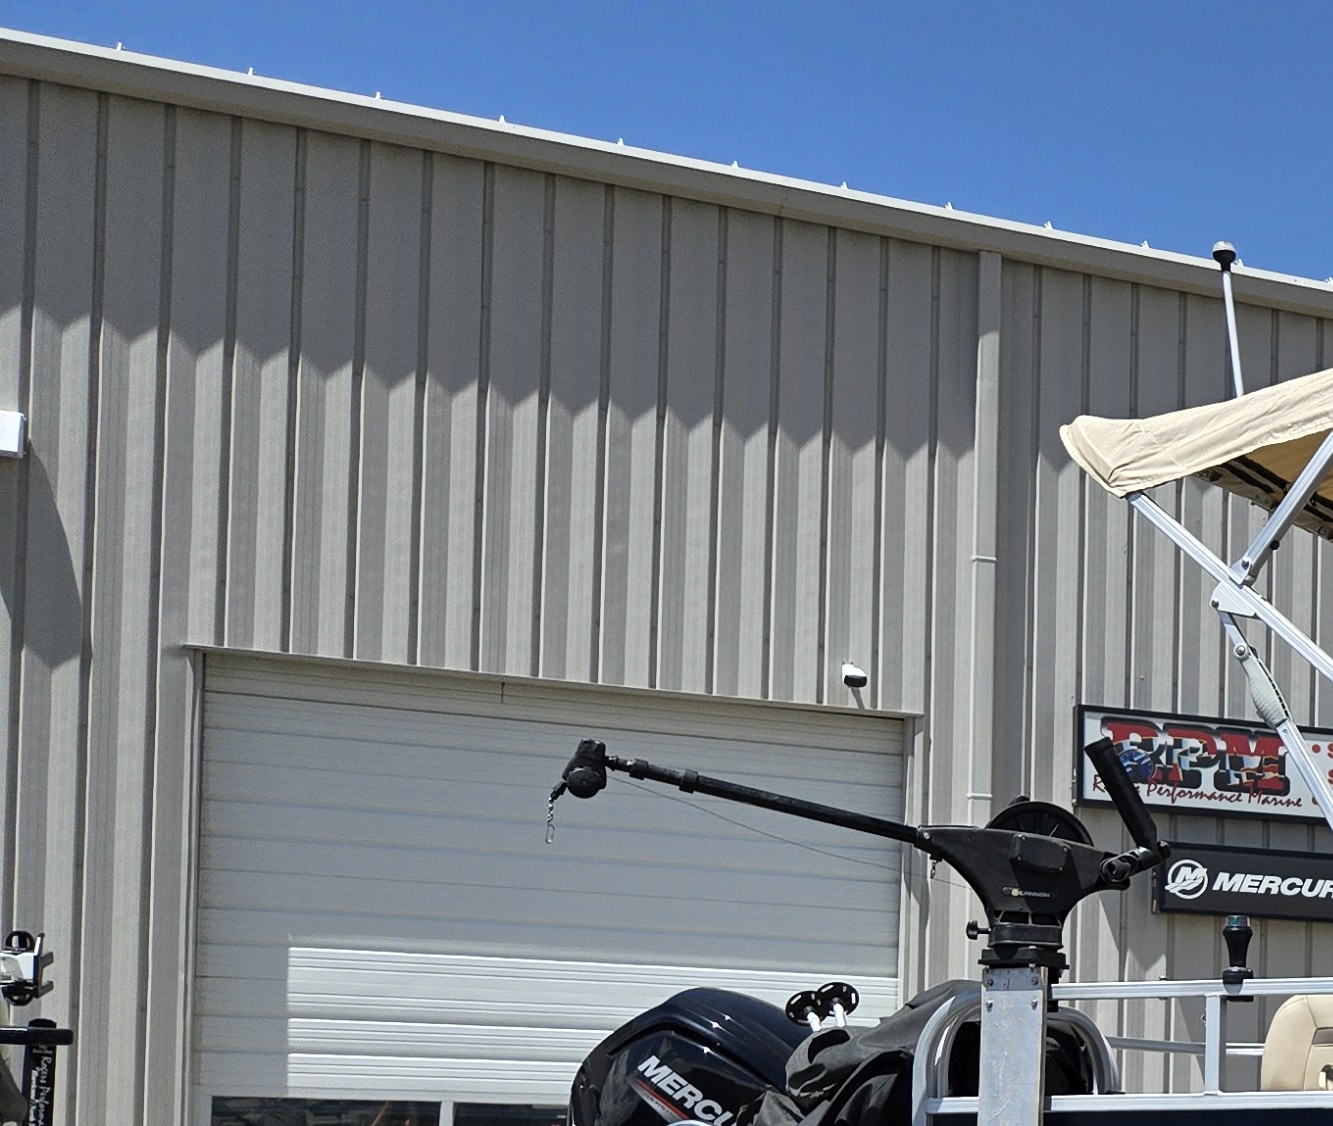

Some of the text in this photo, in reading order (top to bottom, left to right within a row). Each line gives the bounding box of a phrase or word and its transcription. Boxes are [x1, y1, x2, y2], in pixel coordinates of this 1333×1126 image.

[1102, 717, 1289, 795] RPM
[1146, 779, 1243, 804] Performance
[1248, 790, 1303, 808] Marine
